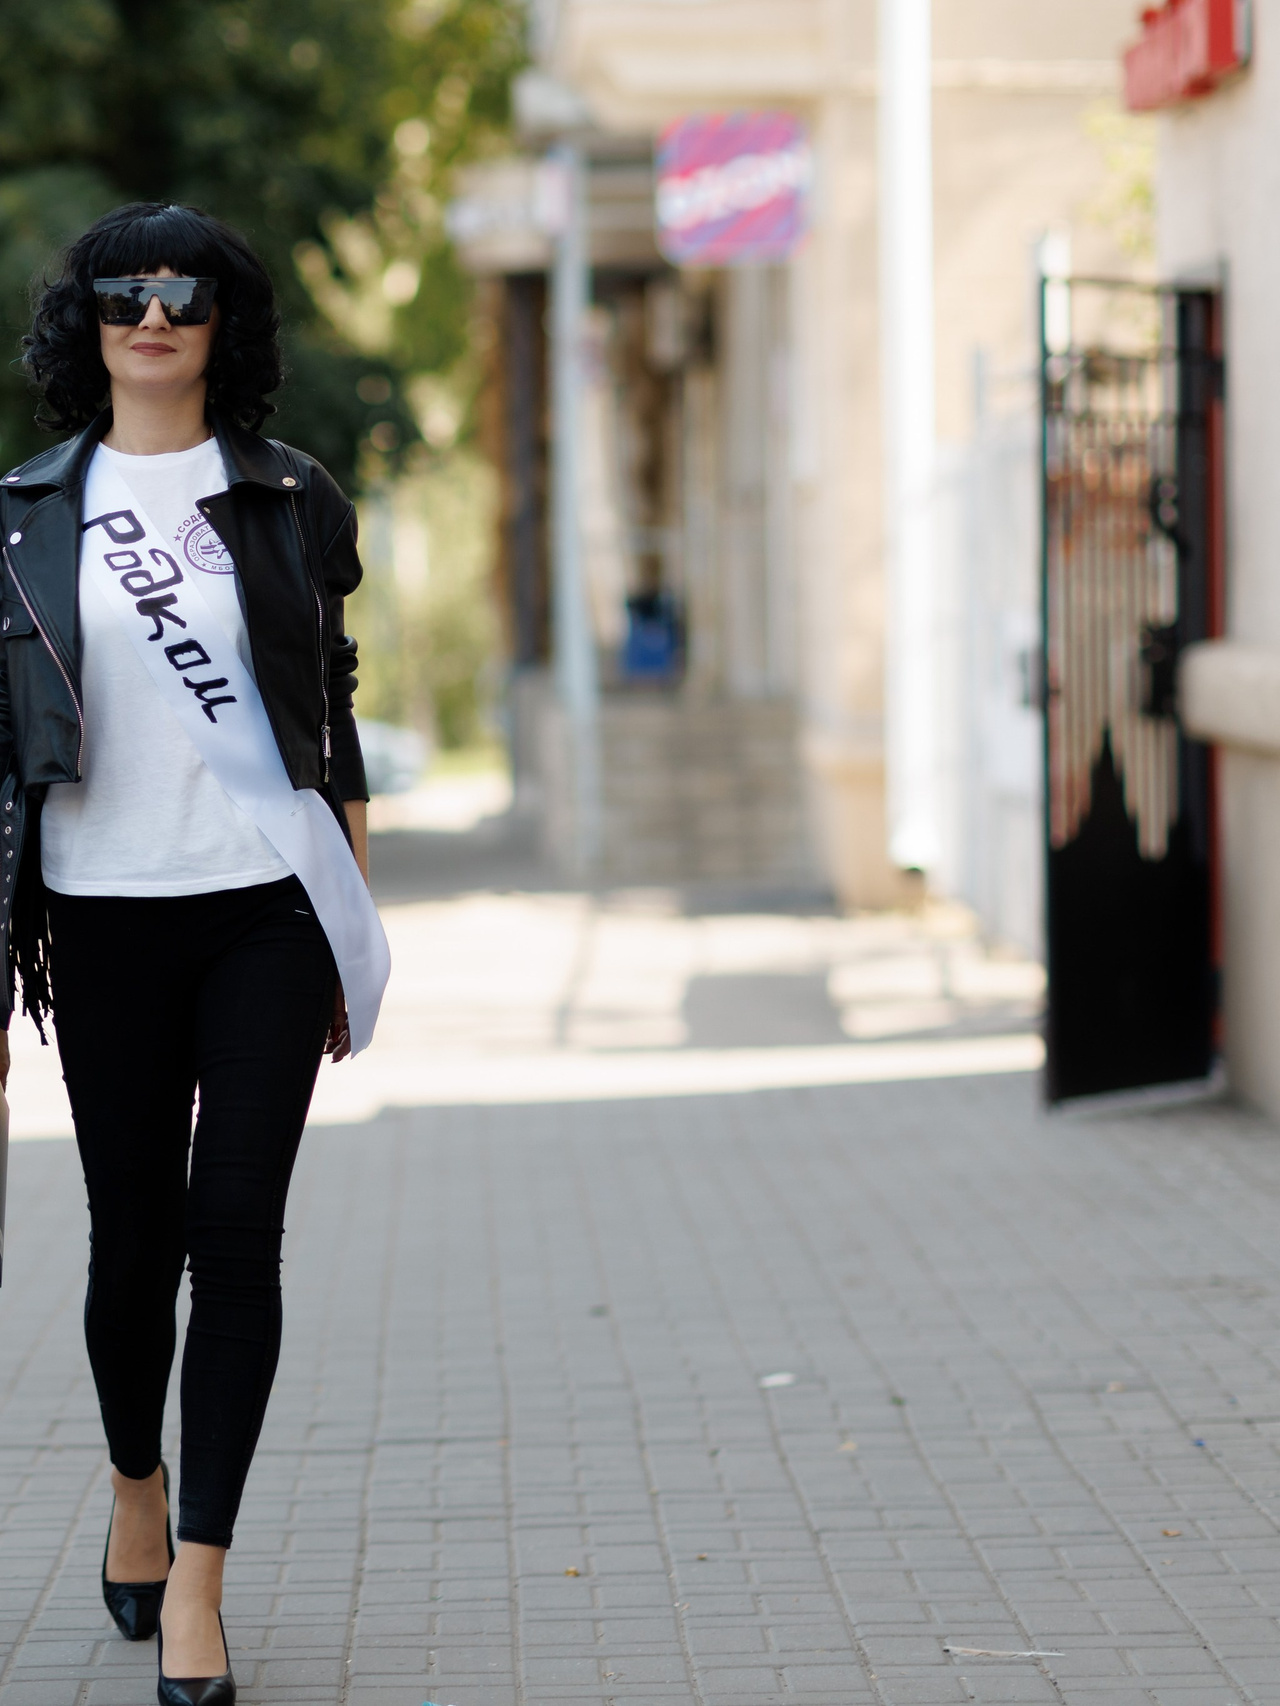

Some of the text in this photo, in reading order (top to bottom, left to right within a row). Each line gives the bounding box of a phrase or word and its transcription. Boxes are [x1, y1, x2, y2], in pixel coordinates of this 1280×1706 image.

[177, 512, 204, 533] СОДР
[190, 525, 211, 562] ОБРАЗОВАТ
[82, 509, 237, 724] Родком
